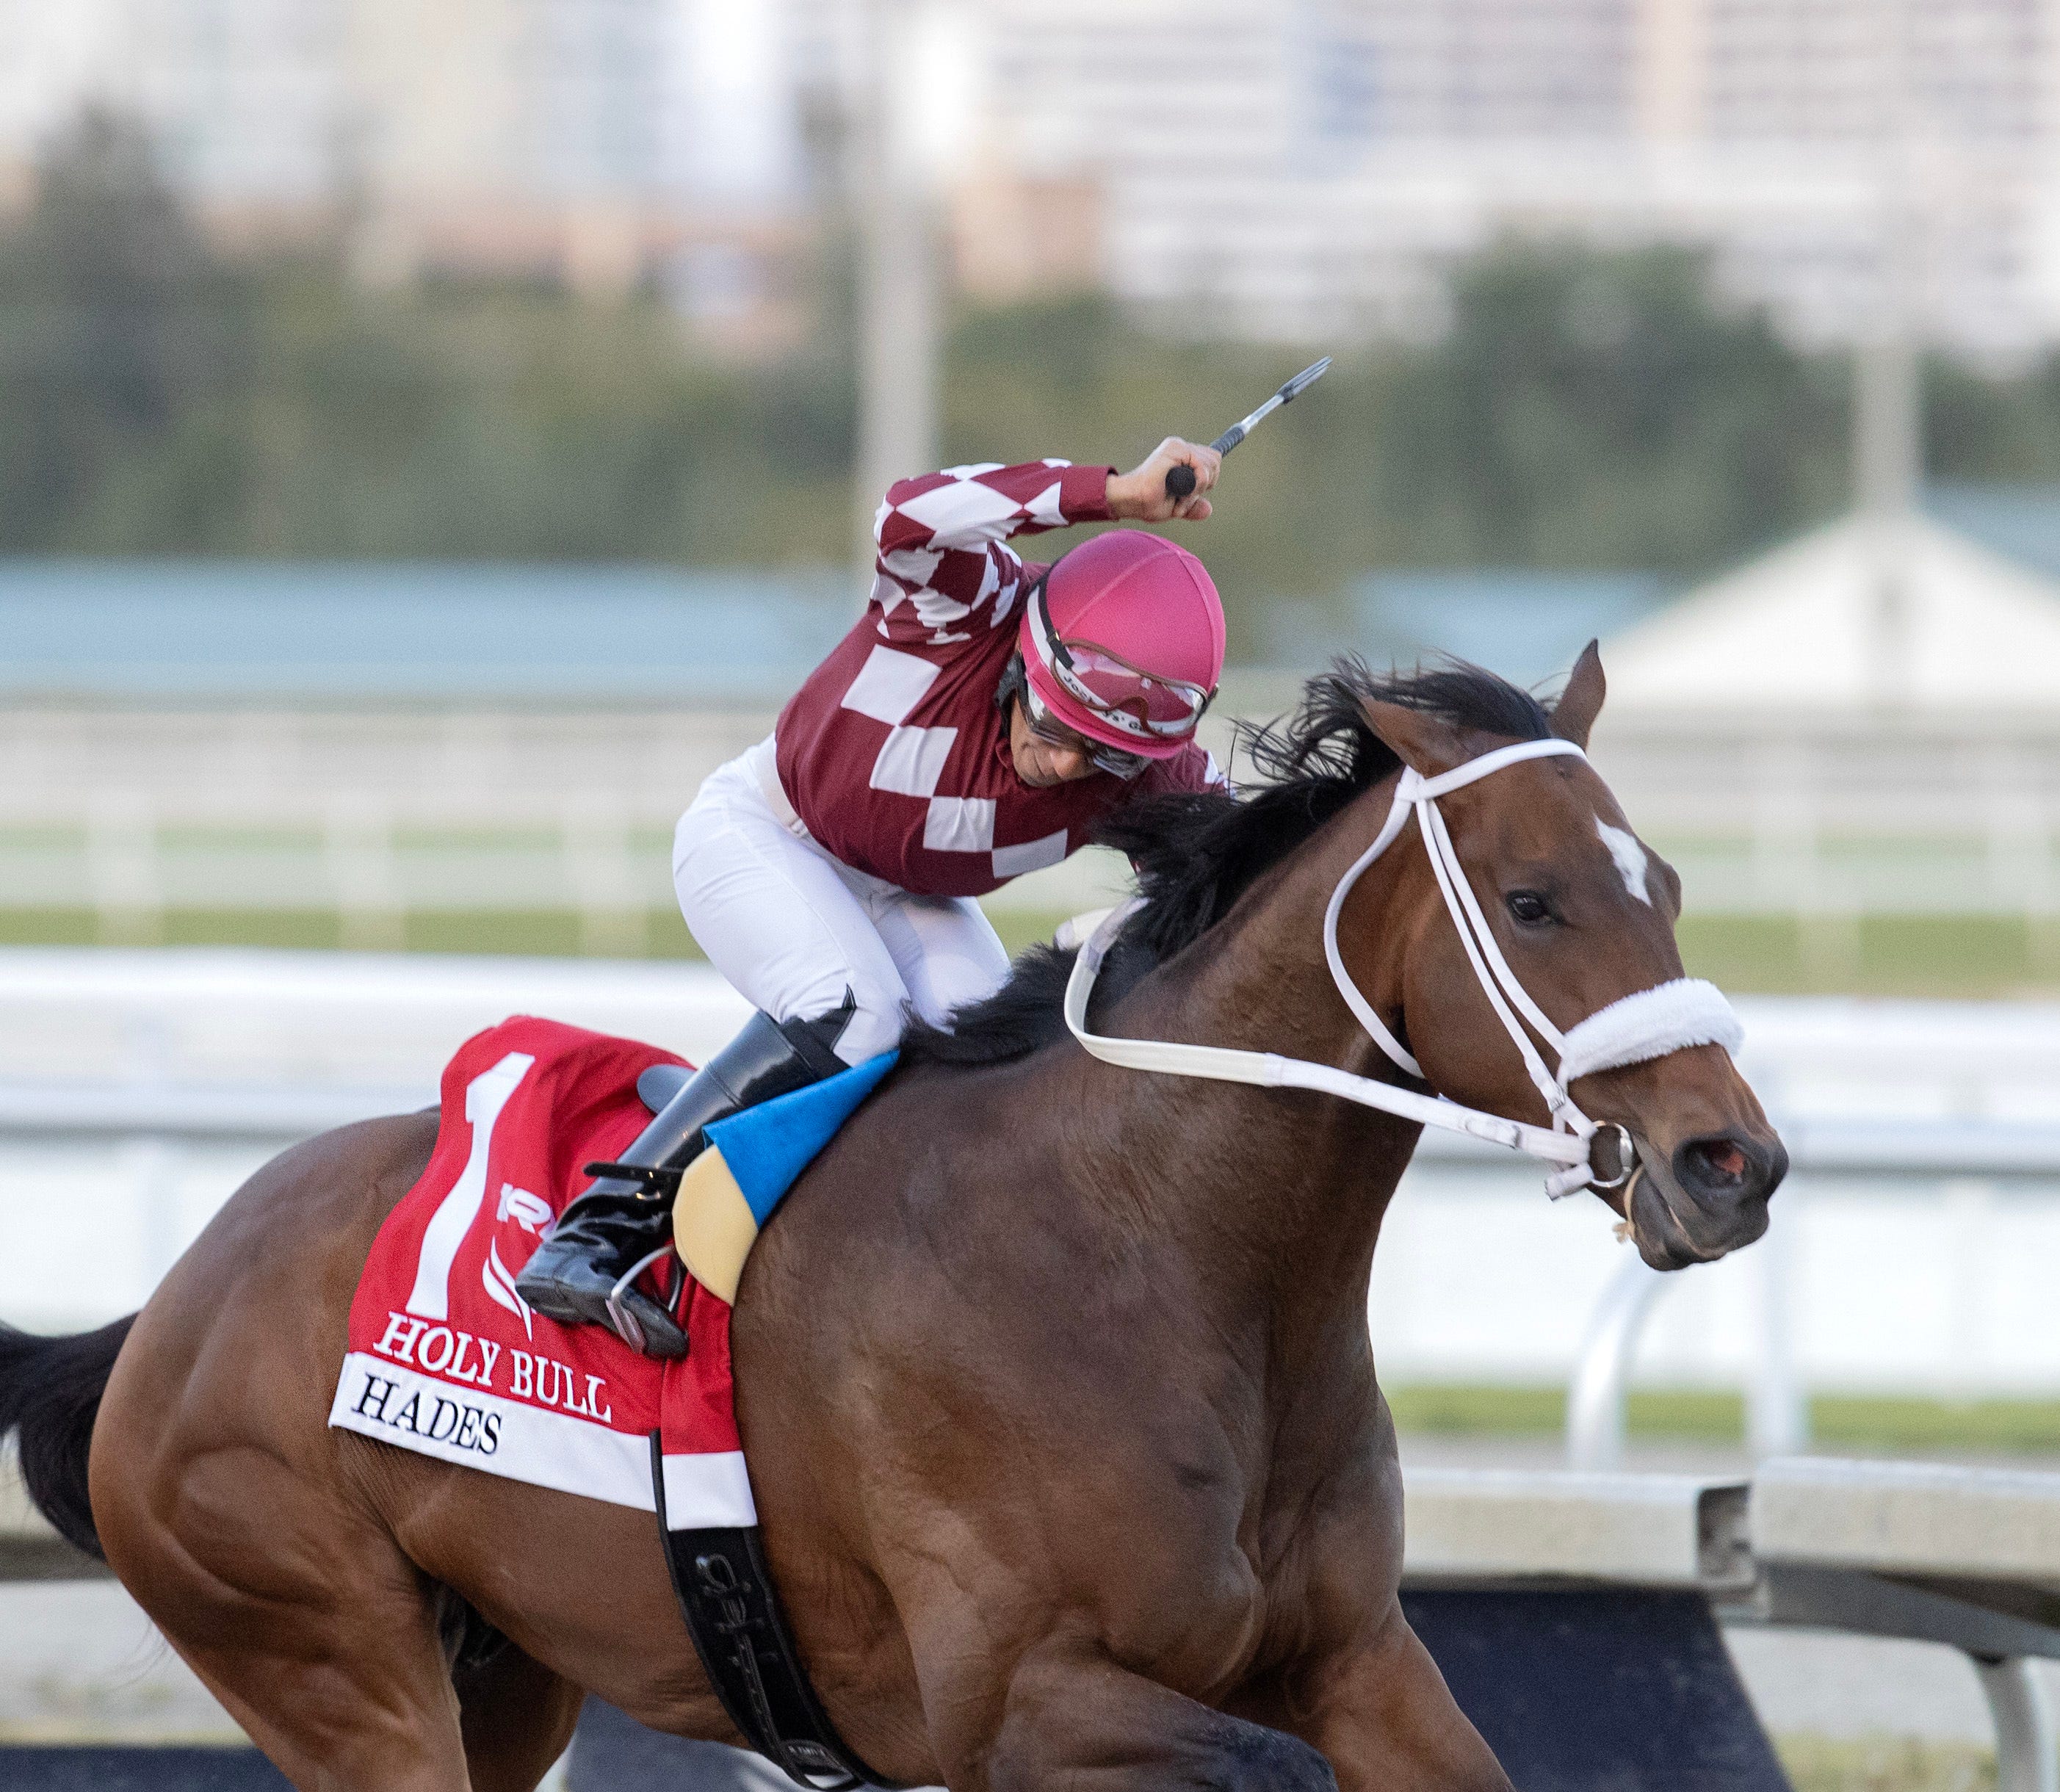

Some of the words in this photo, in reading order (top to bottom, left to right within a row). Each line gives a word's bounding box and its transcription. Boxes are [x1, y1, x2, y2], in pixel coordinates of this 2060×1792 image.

[405, 1052, 535, 1321] 1
[352, 1373, 502, 1455] HADES
[373, 1311, 501, 1387] HOLY
[510, 1349, 612, 1423] BULL
